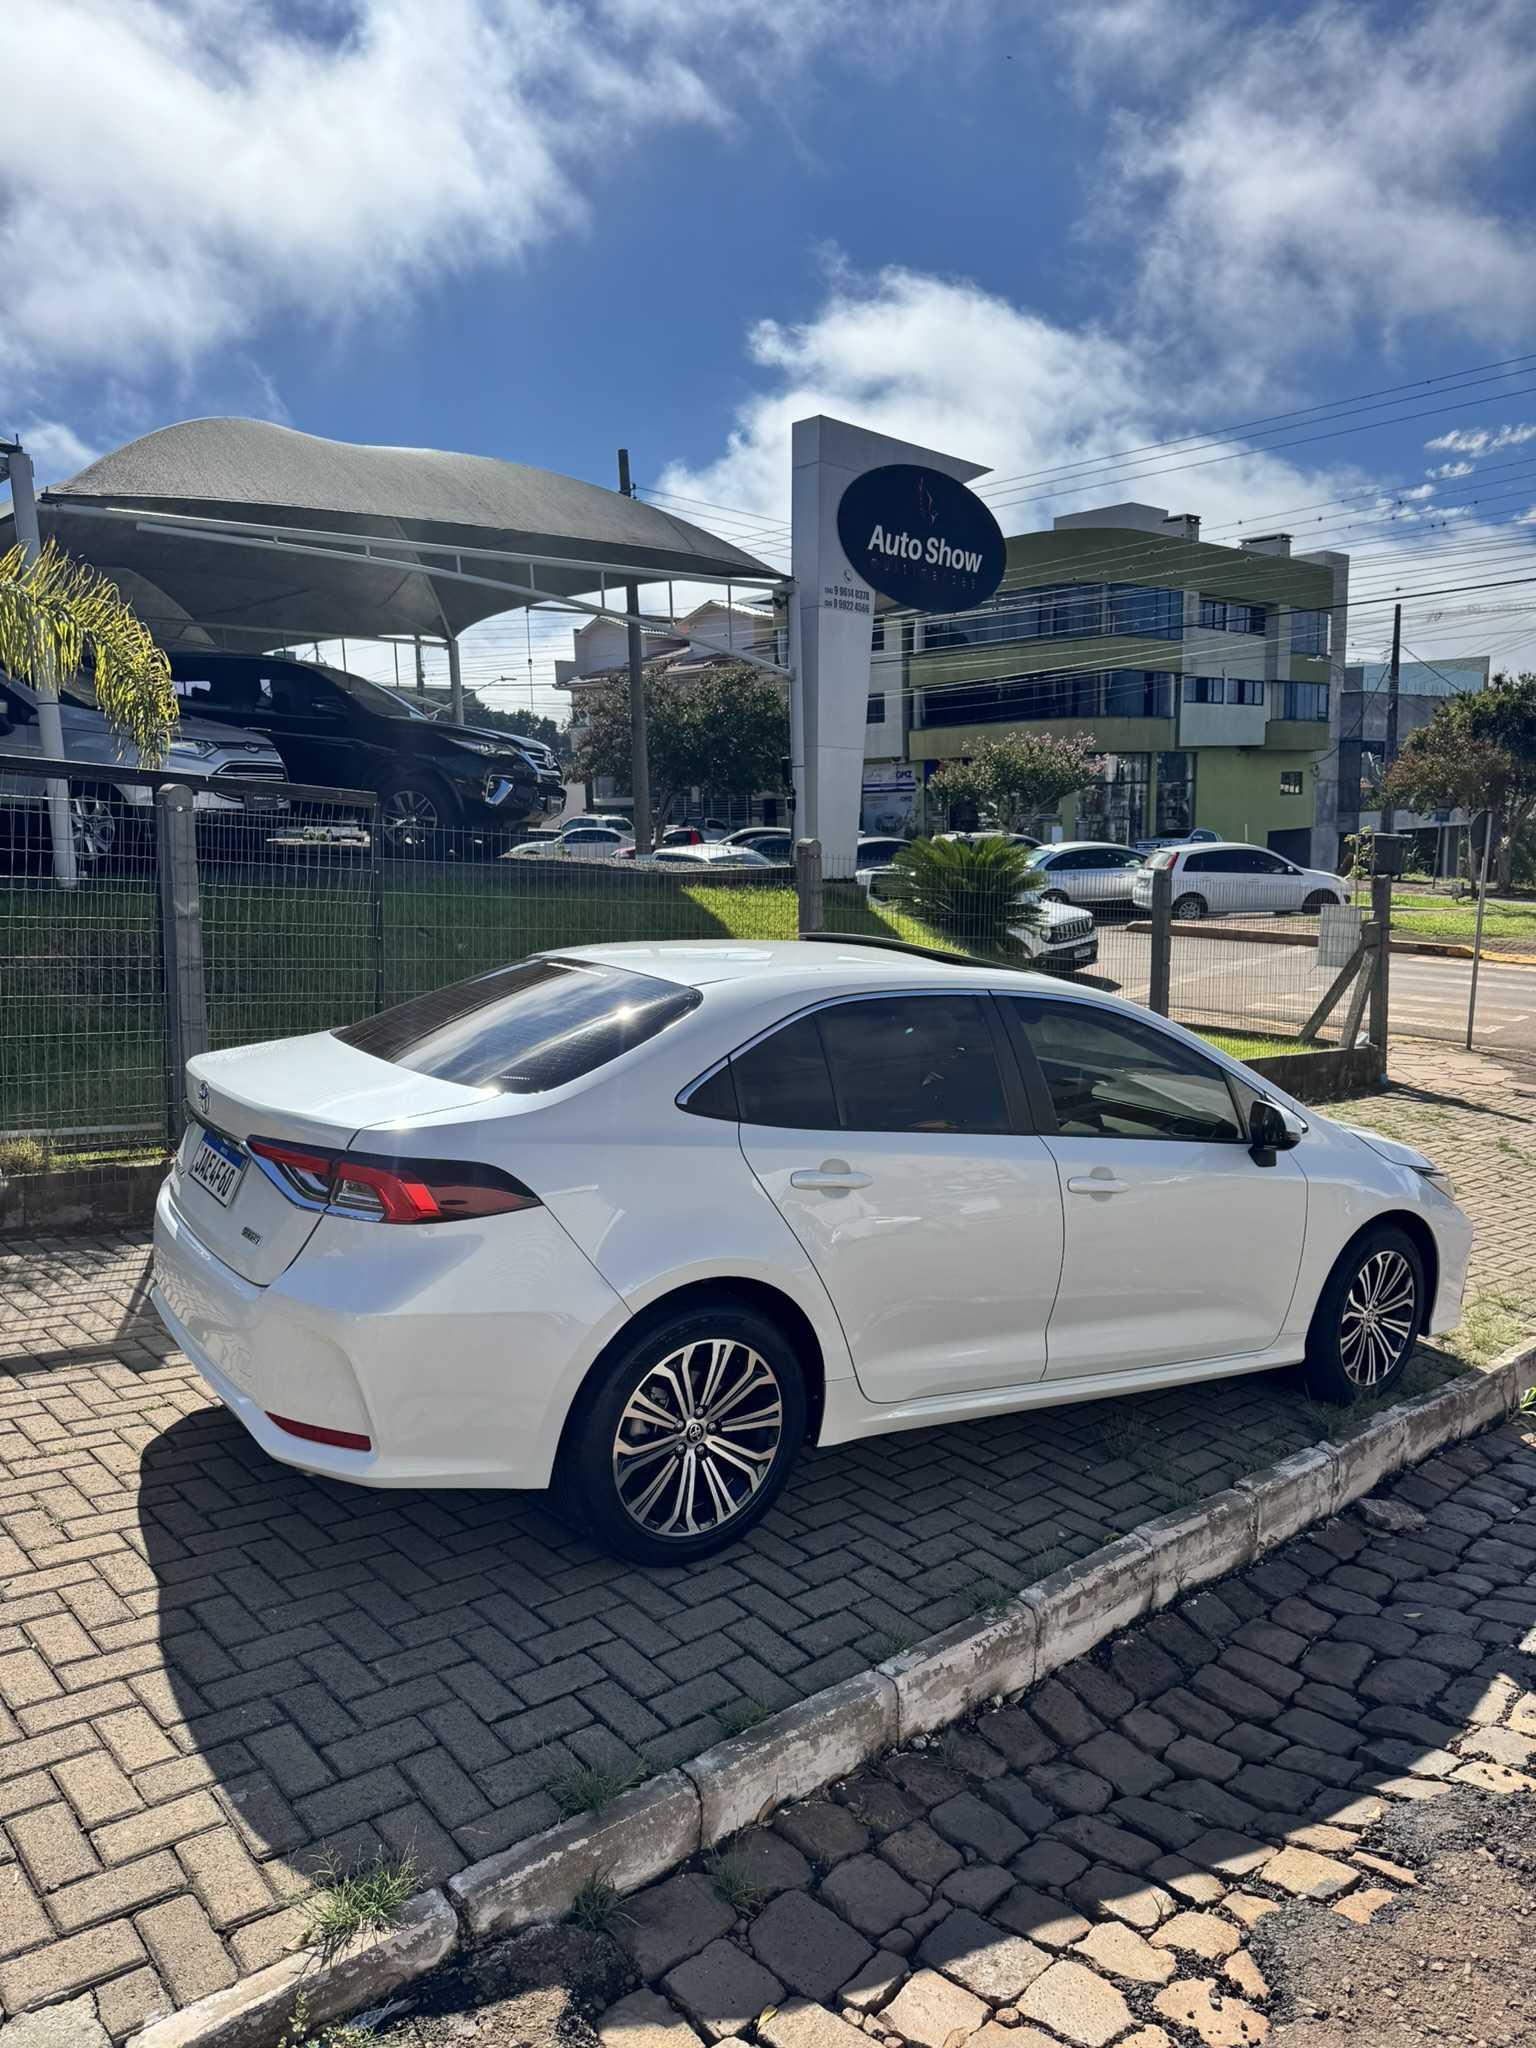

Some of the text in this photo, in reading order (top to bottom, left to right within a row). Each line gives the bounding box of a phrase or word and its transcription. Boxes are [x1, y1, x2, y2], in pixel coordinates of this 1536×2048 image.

[867, 524, 983, 573] Auto Show
[194, 1147, 236, 1197] JAE4F60
